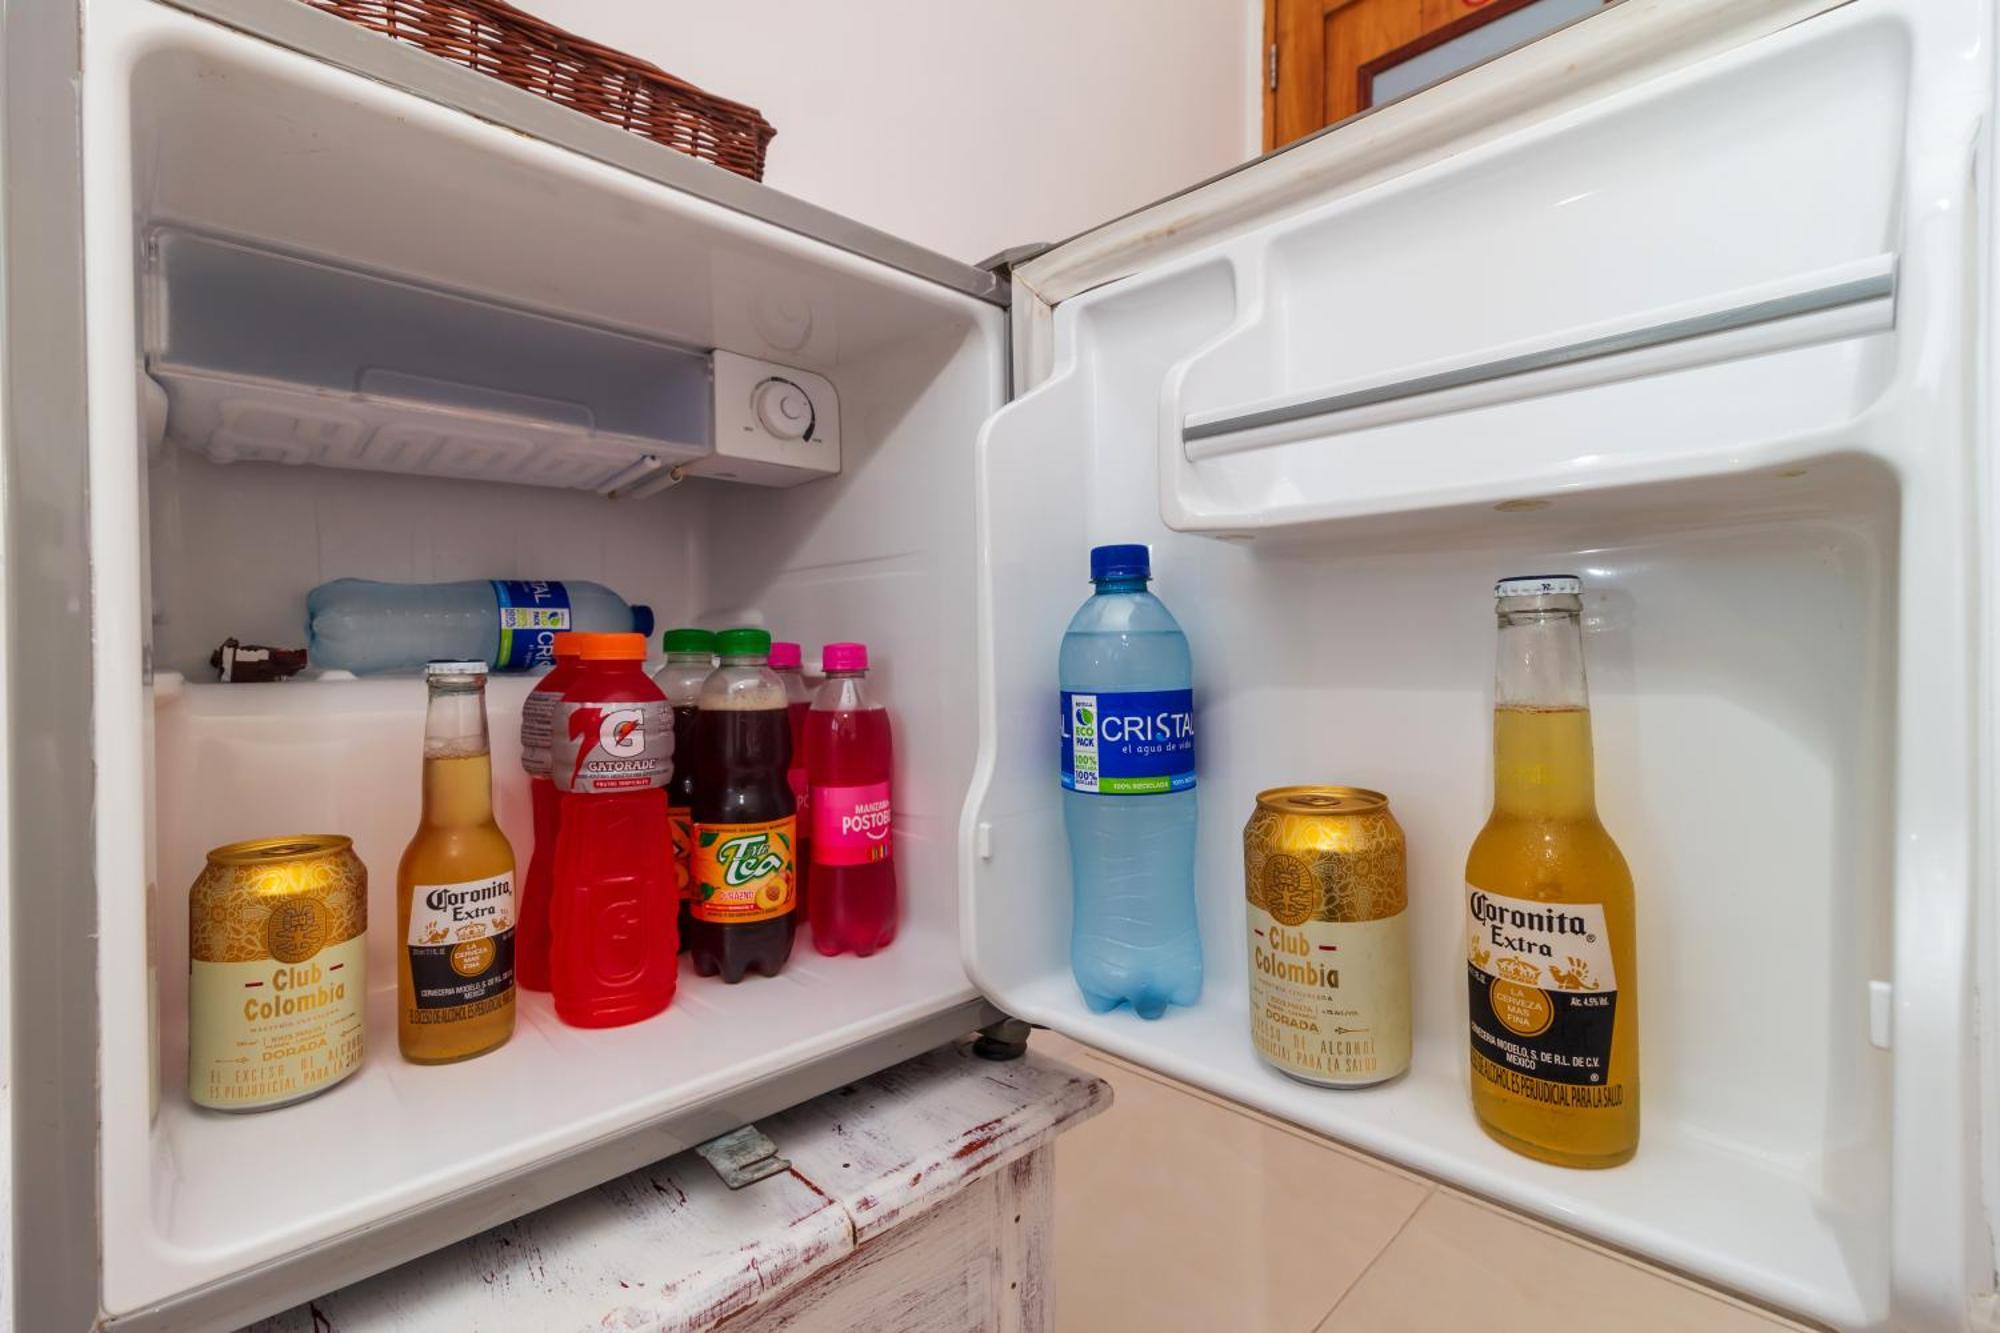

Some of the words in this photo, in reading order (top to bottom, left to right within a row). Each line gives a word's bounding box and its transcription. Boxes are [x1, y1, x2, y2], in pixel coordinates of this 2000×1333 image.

[1075, 726, 1094, 737] ECO
[1076, 737, 1094, 747] PACK
[1122, 744, 1132, 754] el
[1137, 745, 1162, 757] agua
[1166, 742, 1176, 751] de
[588, 759, 656, 773] GATORADE
[1075, 755, 1097, 765] 100%
[1075, 770, 1098, 780] 100%
[426, 881, 510, 913] Coronita
[452, 906, 496, 922] Extra
[1470, 891, 1587, 936] Coronita
[1269, 925, 1311, 957] Club
[1490, 924, 1553, 958] Extra
[1255, 945, 1340, 989] Colombia
[272, 963, 322, 993] Club
[243, 982, 345, 1021] Colombia
[1496, 992, 1543, 1012] CERVEZA
[1509, 988, 1525, 998] LA
[1265, 1008, 1320, 1033] DORADA
[1507, 1005, 1531, 1018] MAS
[1507, 1014, 1531, 1027] FINA
[262, 1038, 328, 1061] DORADA
[1320, 1038, 1376, 1056] ALCOHOL
[1505, 1053, 1536, 1071] MEXICO
[1540, 1051, 1553, 1064] DE
[1572, 1056, 1584, 1068] DE
[1510, 1073, 1521, 1095] ES
[1520, 1075, 1571, 1107] PERJUDICIAL
[1571, 1085, 1592, 1108] PARA
[1592, 1086, 1602, 1109] LA
[1602, 1083, 1624, 1108] SALUD
